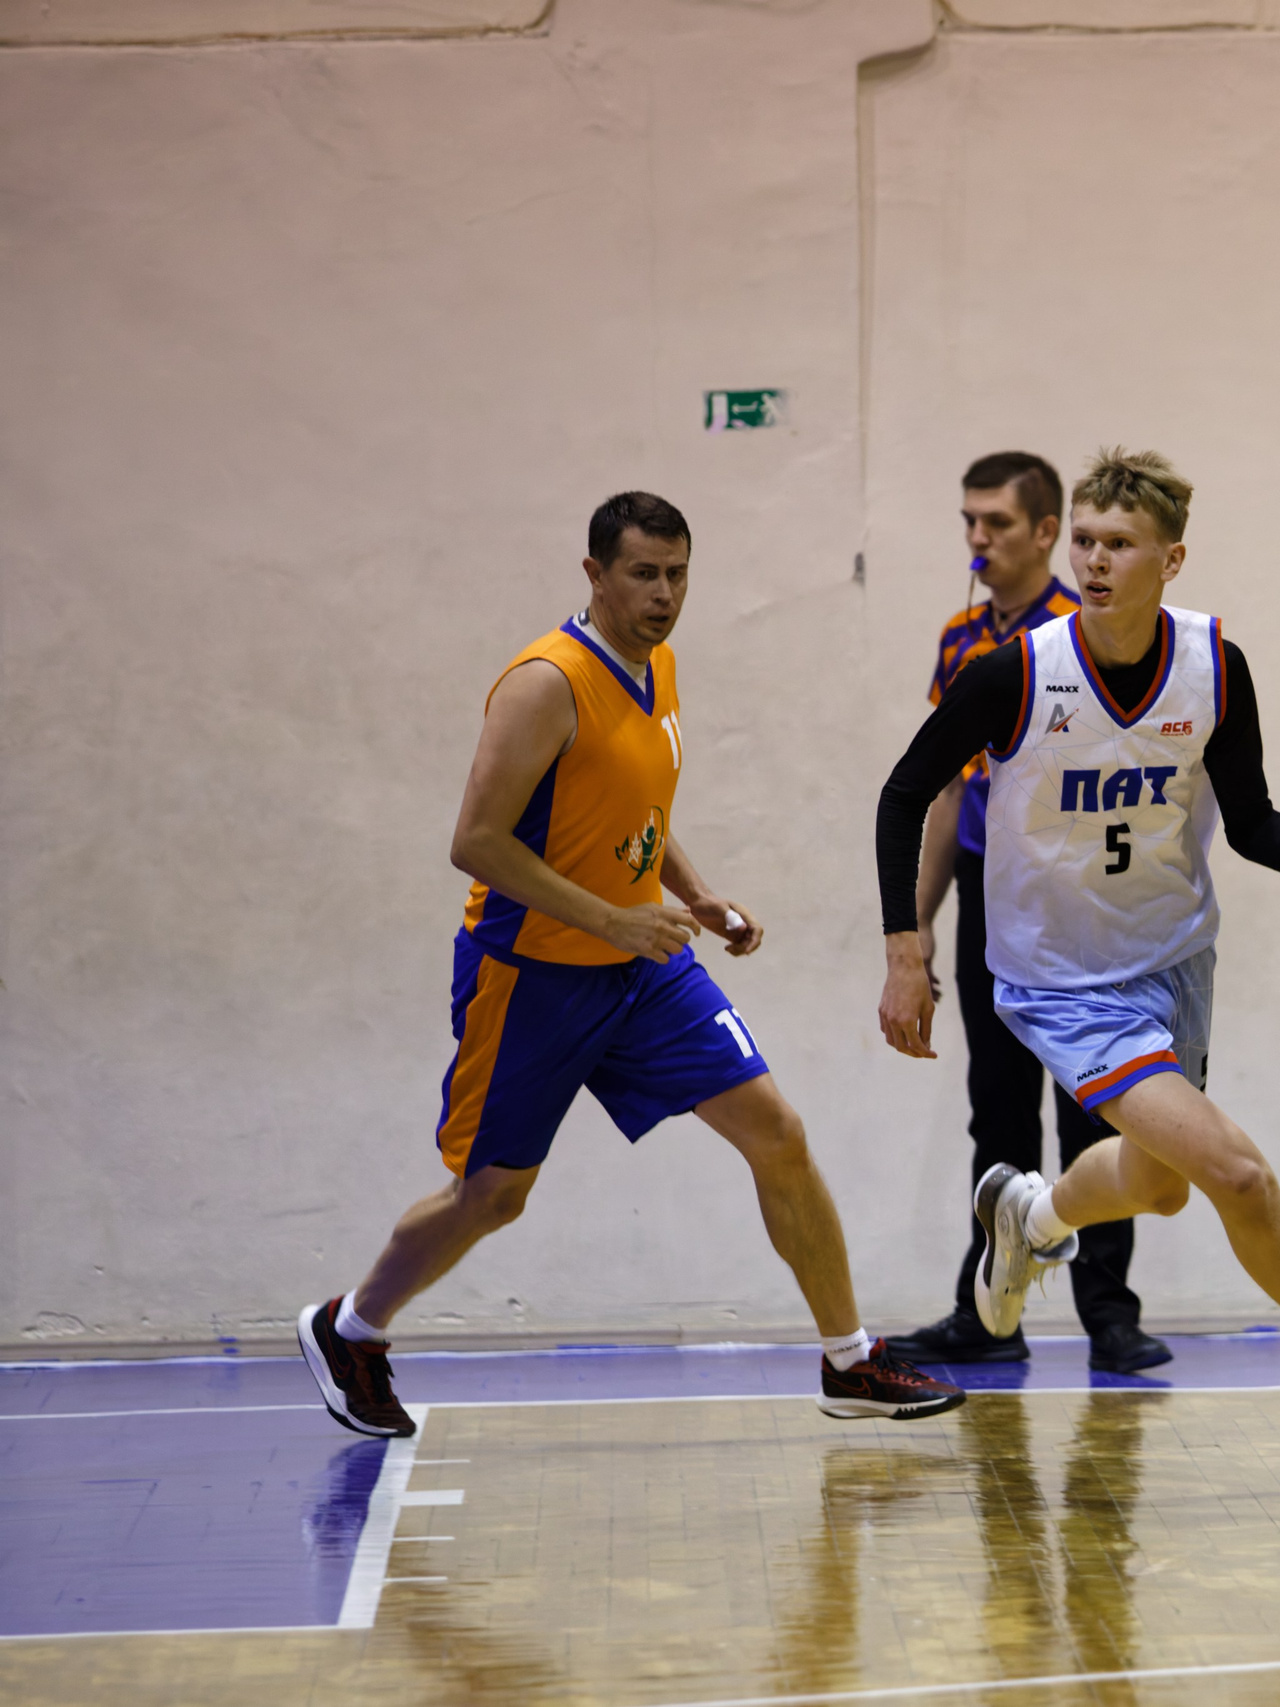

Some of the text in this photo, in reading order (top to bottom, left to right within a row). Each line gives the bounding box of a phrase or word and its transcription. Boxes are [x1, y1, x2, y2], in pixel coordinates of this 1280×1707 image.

[1046, 685, 1079, 693] MAXX
[1060, 766, 1178, 812] ПАТ
[1105, 823, 1131, 875] 5
[1077, 1064, 1109, 1082] MAXX
